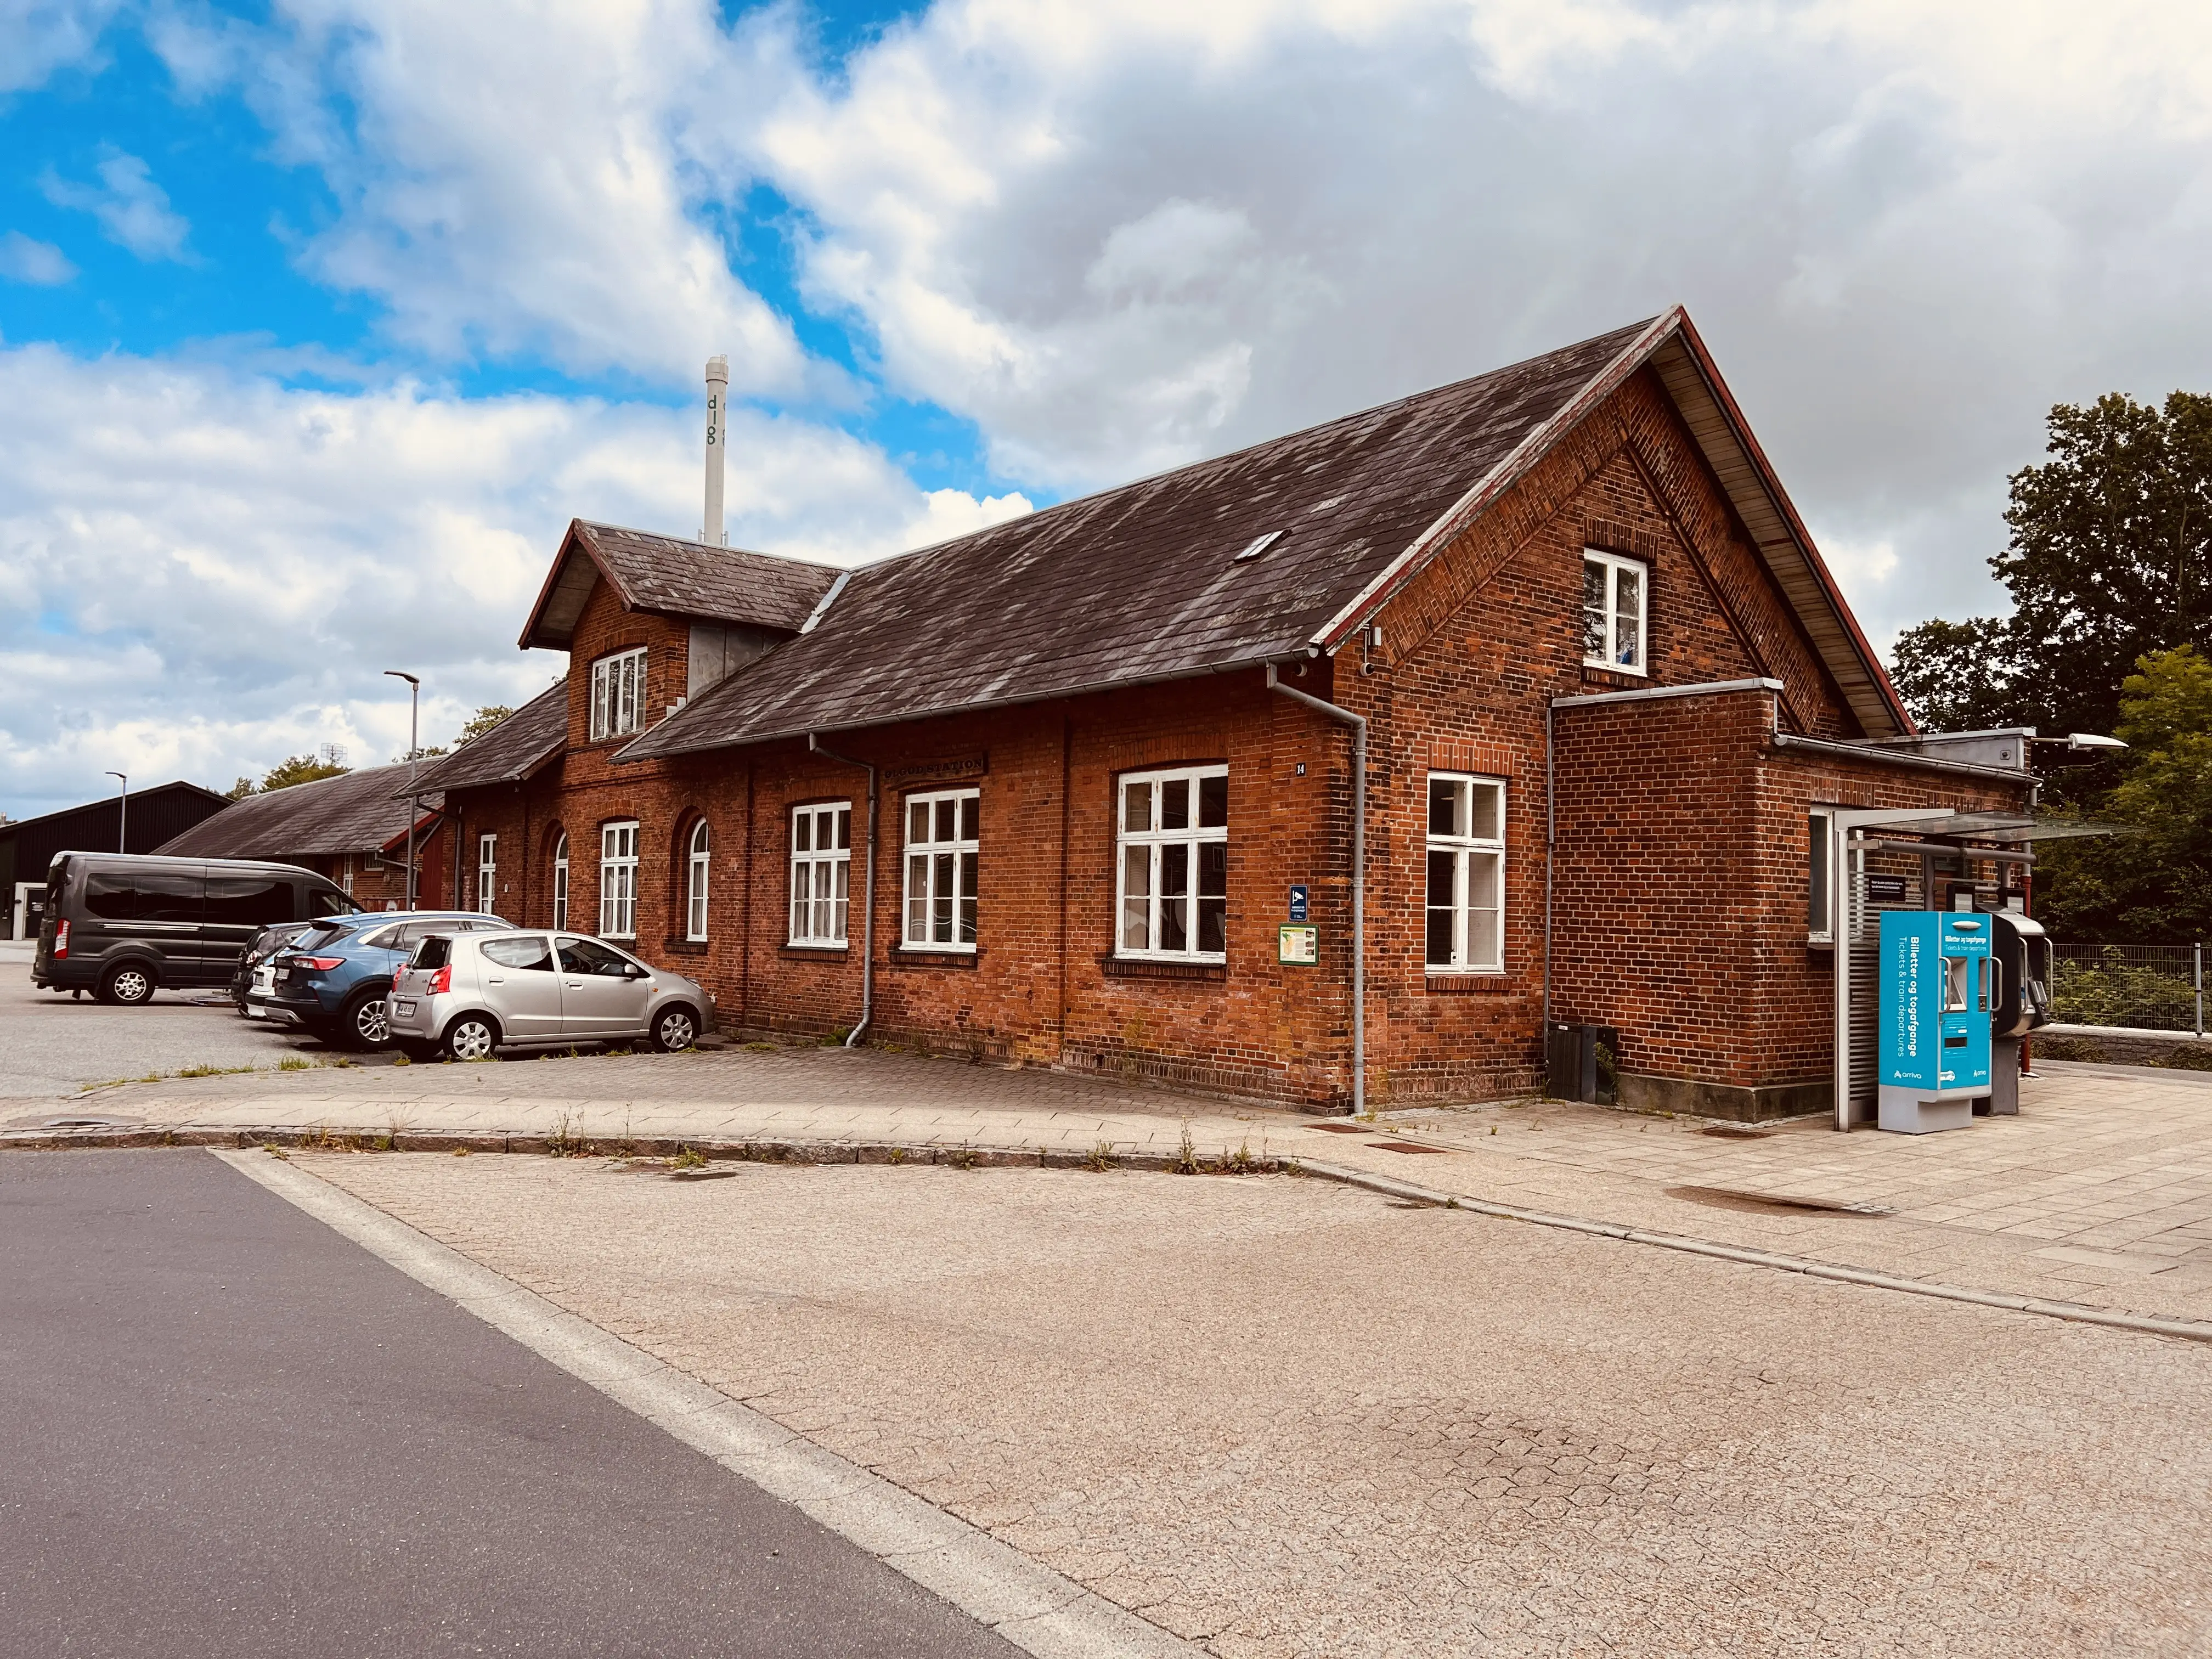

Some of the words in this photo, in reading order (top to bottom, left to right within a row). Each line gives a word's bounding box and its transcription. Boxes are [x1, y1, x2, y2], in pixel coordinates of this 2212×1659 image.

[927, 759, 982, 774] STATION
[1297, 764, 1304, 774] 14
[1899, 936, 1907, 969] Tickets
[1910, 936, 1920, 979] Billetter
[1898, 980, 1906, 1002] train
[1908, 980, 1917, 994] og
[1897, 1005, 1906, 1057] departures
[1908, 996, 1919, 1057] togafgange
